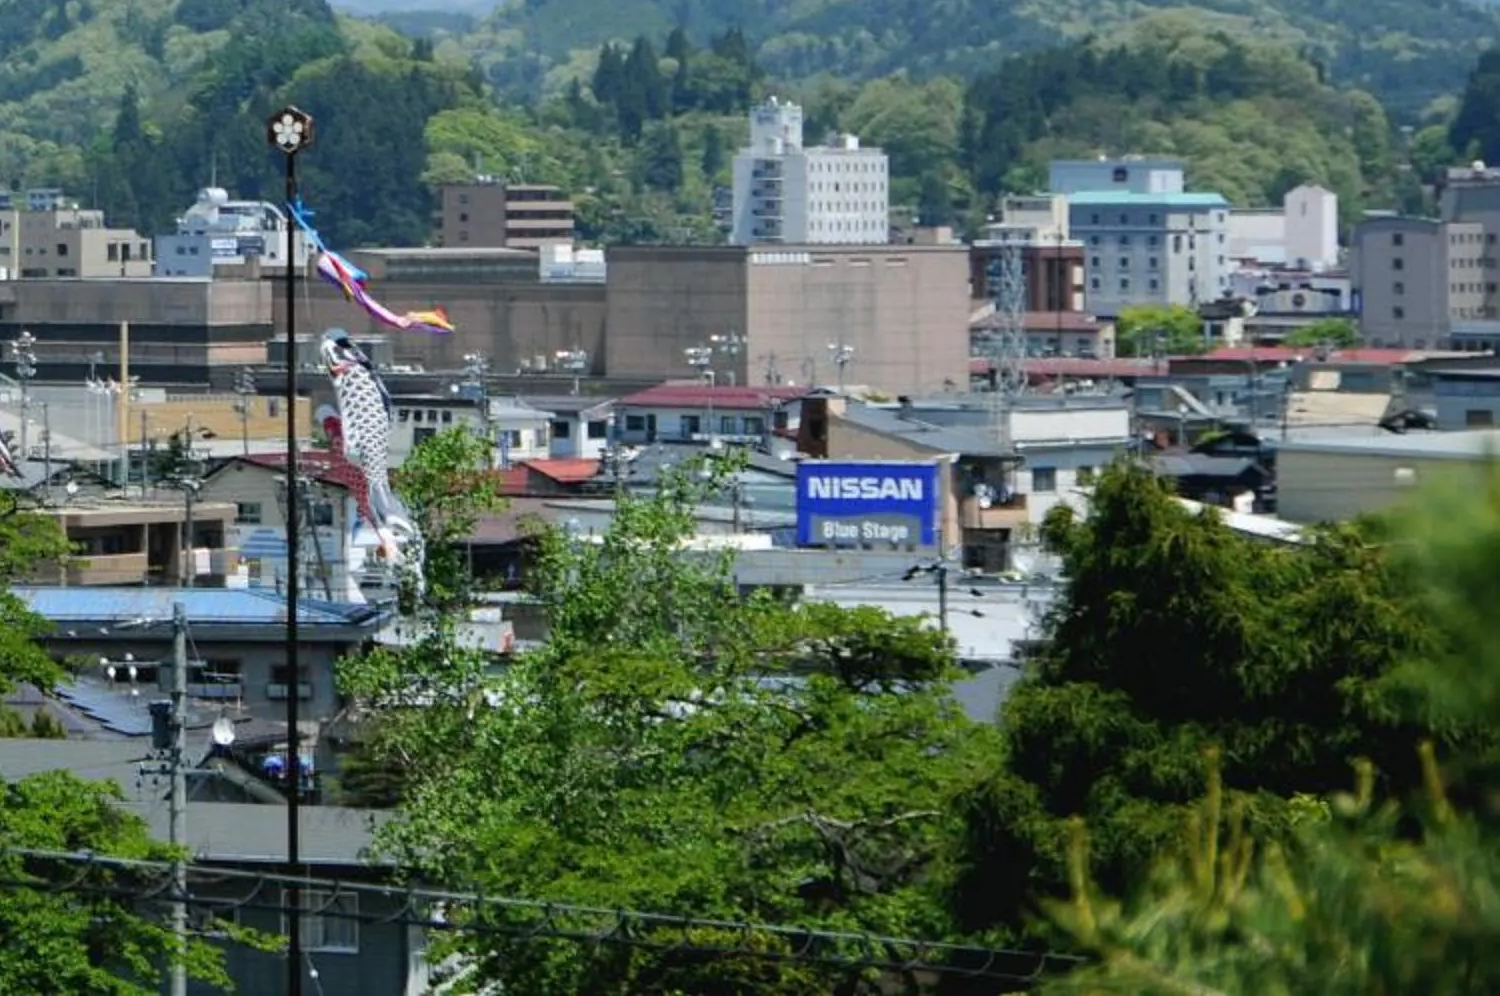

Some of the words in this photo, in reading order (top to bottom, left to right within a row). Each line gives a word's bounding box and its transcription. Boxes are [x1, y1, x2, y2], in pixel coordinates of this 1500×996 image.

[808, 477, 923, 499] NISSAN
[823, 521, 858, 538] Blue
[861, 521, 909, 542] Stage
